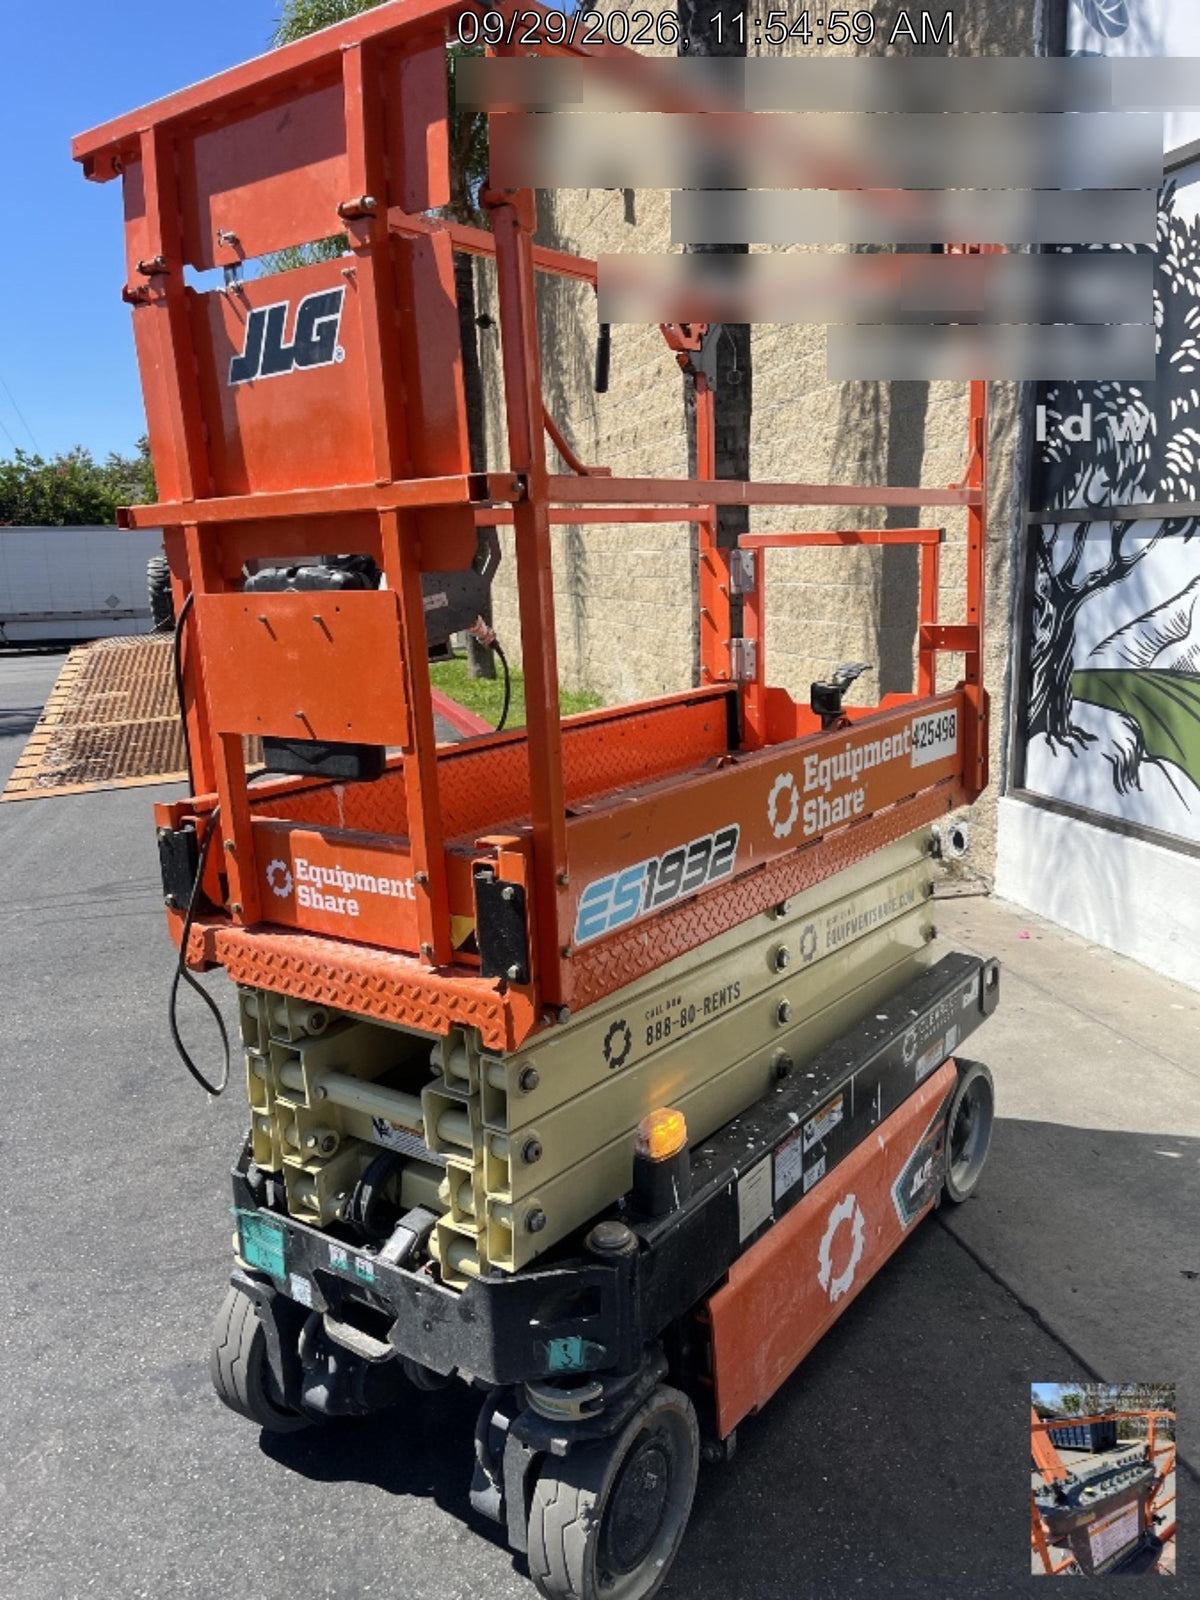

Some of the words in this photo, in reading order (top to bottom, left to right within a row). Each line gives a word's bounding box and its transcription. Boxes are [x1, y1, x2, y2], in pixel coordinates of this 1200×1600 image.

[912, 714, 956, 749] 425498
[803, 724, 911, 792] Equipment
[803, 787, 866, 836] Share
[294, 857, 416, 901] Equipment
[297, 885, 360, 917] Share
[574, 823, 740, 947] ES1932
[646, 981, 741, 1046] 888-80-RENTS
